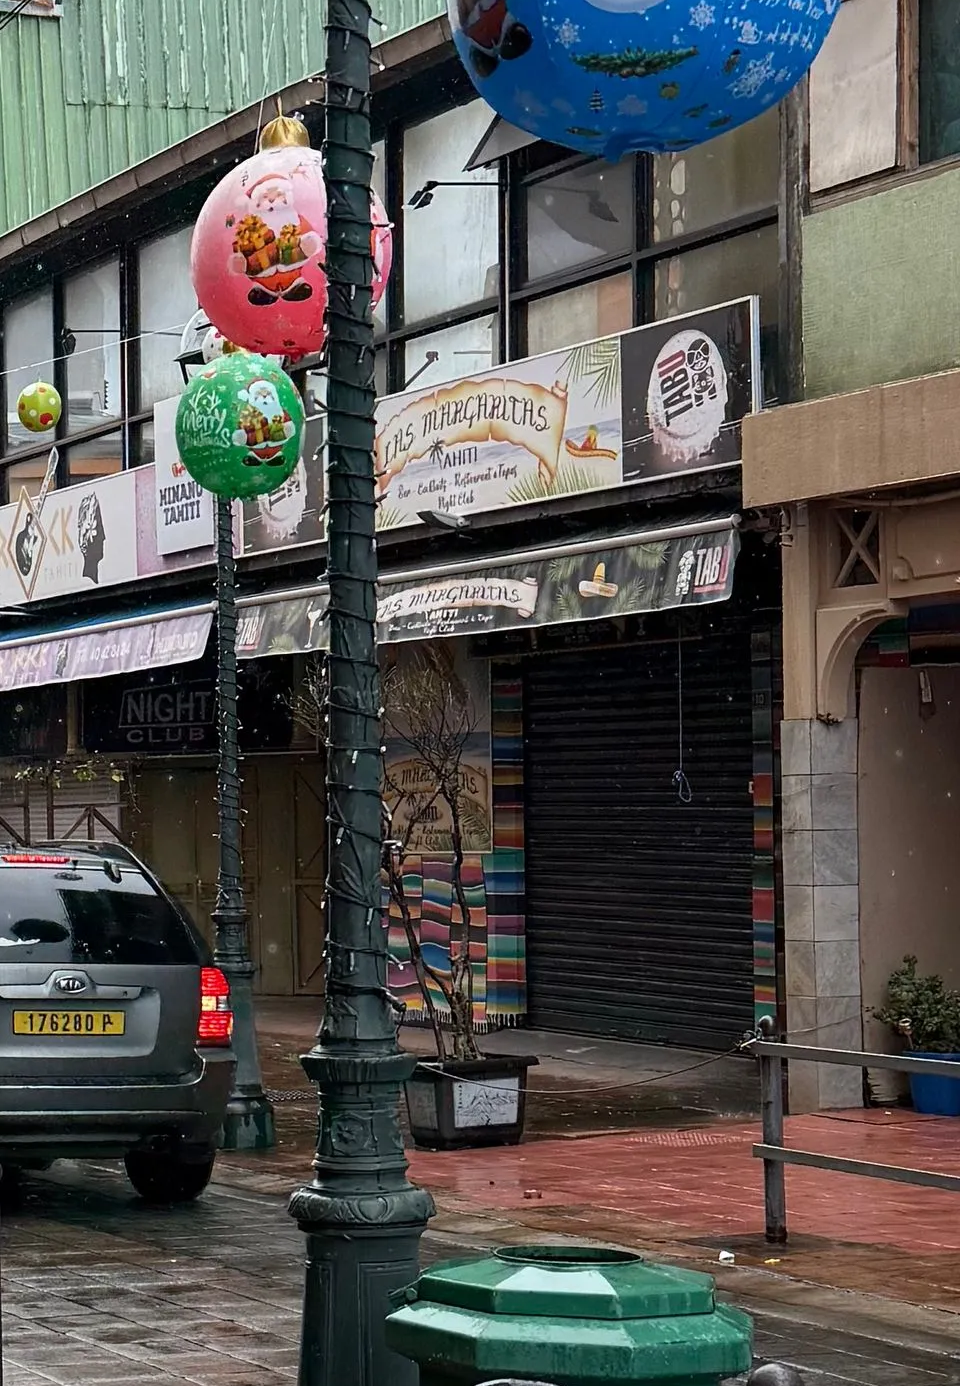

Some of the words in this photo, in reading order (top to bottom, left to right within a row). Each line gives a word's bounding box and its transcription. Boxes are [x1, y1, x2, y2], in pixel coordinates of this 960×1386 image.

[657, 350, 693, 427] TABU
[183, 407, 227, 434] Merry
[384, 423, 416, 469] LAS
[421, 392, 551, 437] MARGARITAS
[163, 500, 201, 525] TAHITI
[695, 545, 730, 586] TABU
[409, 585, 522, 608] MARGARITAS
[127, 691, 212, 723] NIGHT
[126, 727, 205, 743] CLUB
[59, 979, 82, 990] KIA
[27, 1014, 94, 1032] 176280
[102, 1015, 113, 1032] P
